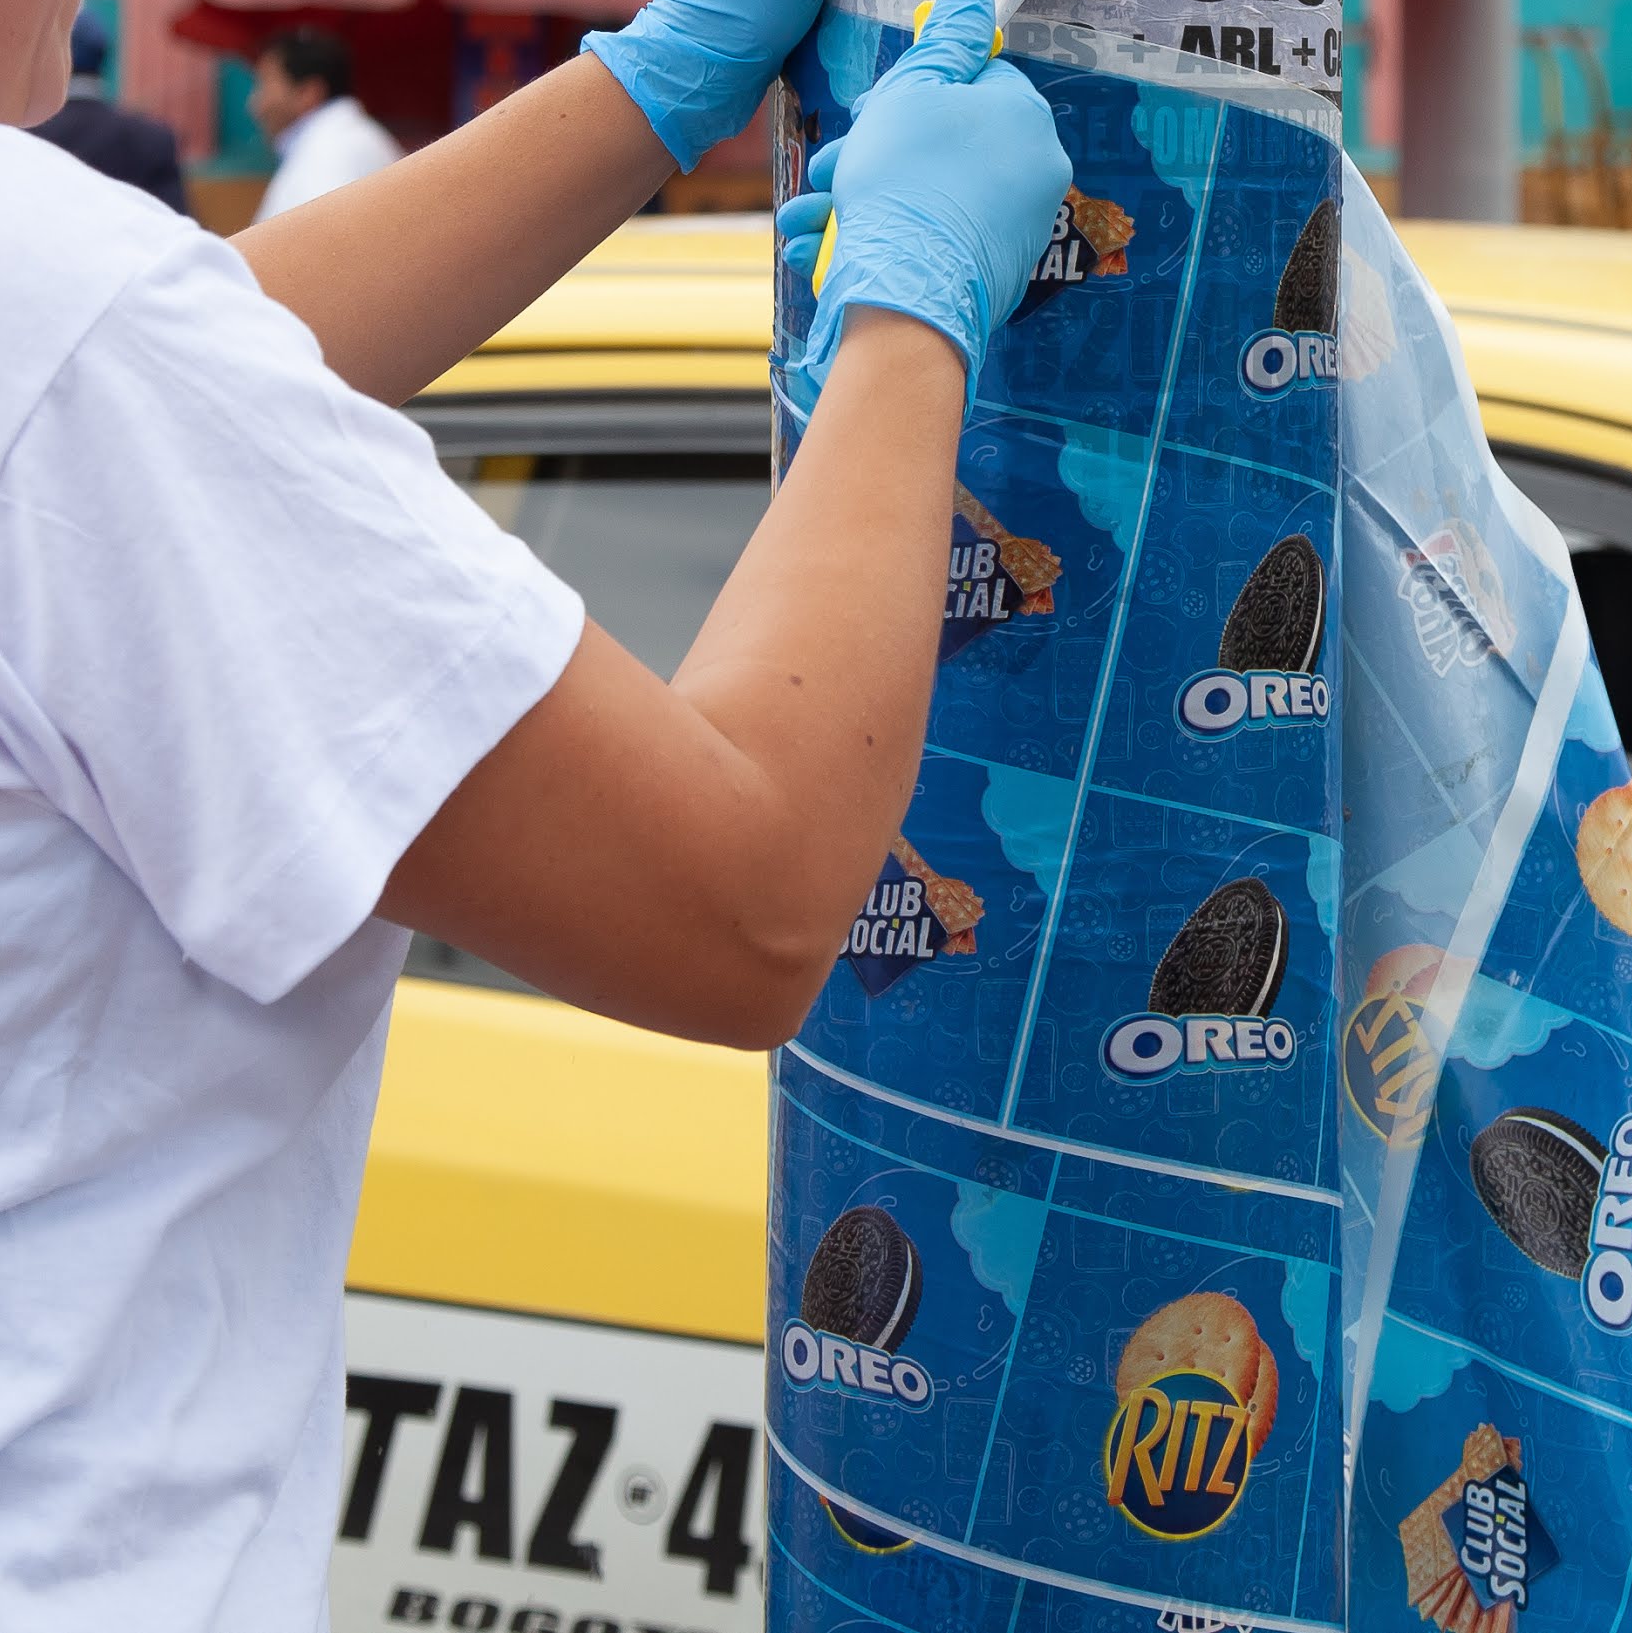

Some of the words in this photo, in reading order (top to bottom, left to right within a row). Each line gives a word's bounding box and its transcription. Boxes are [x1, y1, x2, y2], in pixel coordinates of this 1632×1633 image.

[1175, 24, 1282, 76] ARL
[1182, 674, 1329, 730] OREO
[1108, 1018, 1293, 1076] OREO
[782, 1320, 930, 1404] OREO
[338, 1375, 619, 1580] TAZ
[665, 1422, 764, 1596] 4
[1107, 1383, 1256, 1507] RITZ
[1462, 1481, 1495, 1576] CLUB
